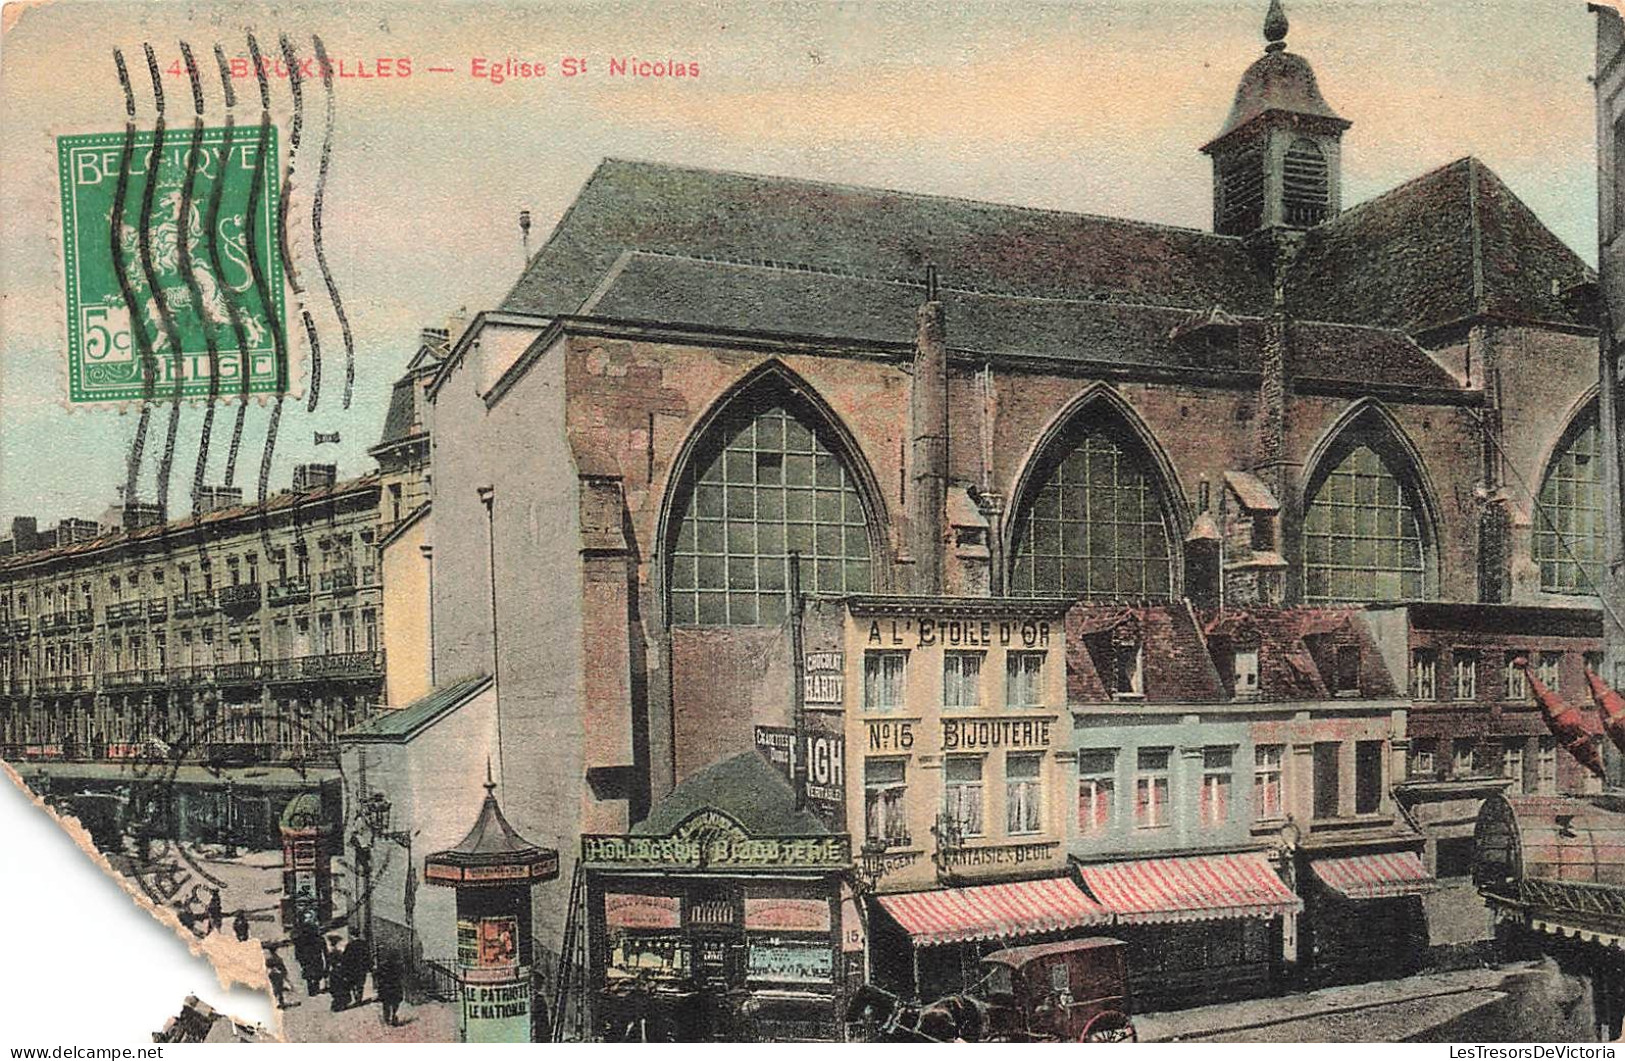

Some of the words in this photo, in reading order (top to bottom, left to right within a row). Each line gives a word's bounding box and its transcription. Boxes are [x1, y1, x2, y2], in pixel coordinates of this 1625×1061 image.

[868, 620, 882, 645] A
[917, 618, 991, 649] ETOILE
[1000, 619, 1050, 648] D'OR
[804, 675, 842, 702] HARDY
[943, 721, 1050, 750] BIJOUTERIE
[846, 930, 860, 944] 15
[466, 986, 477, 1002] LE
[480, 983, 529, 1003] PATRIOTE
[469, 1003, 479, 1019] LE
